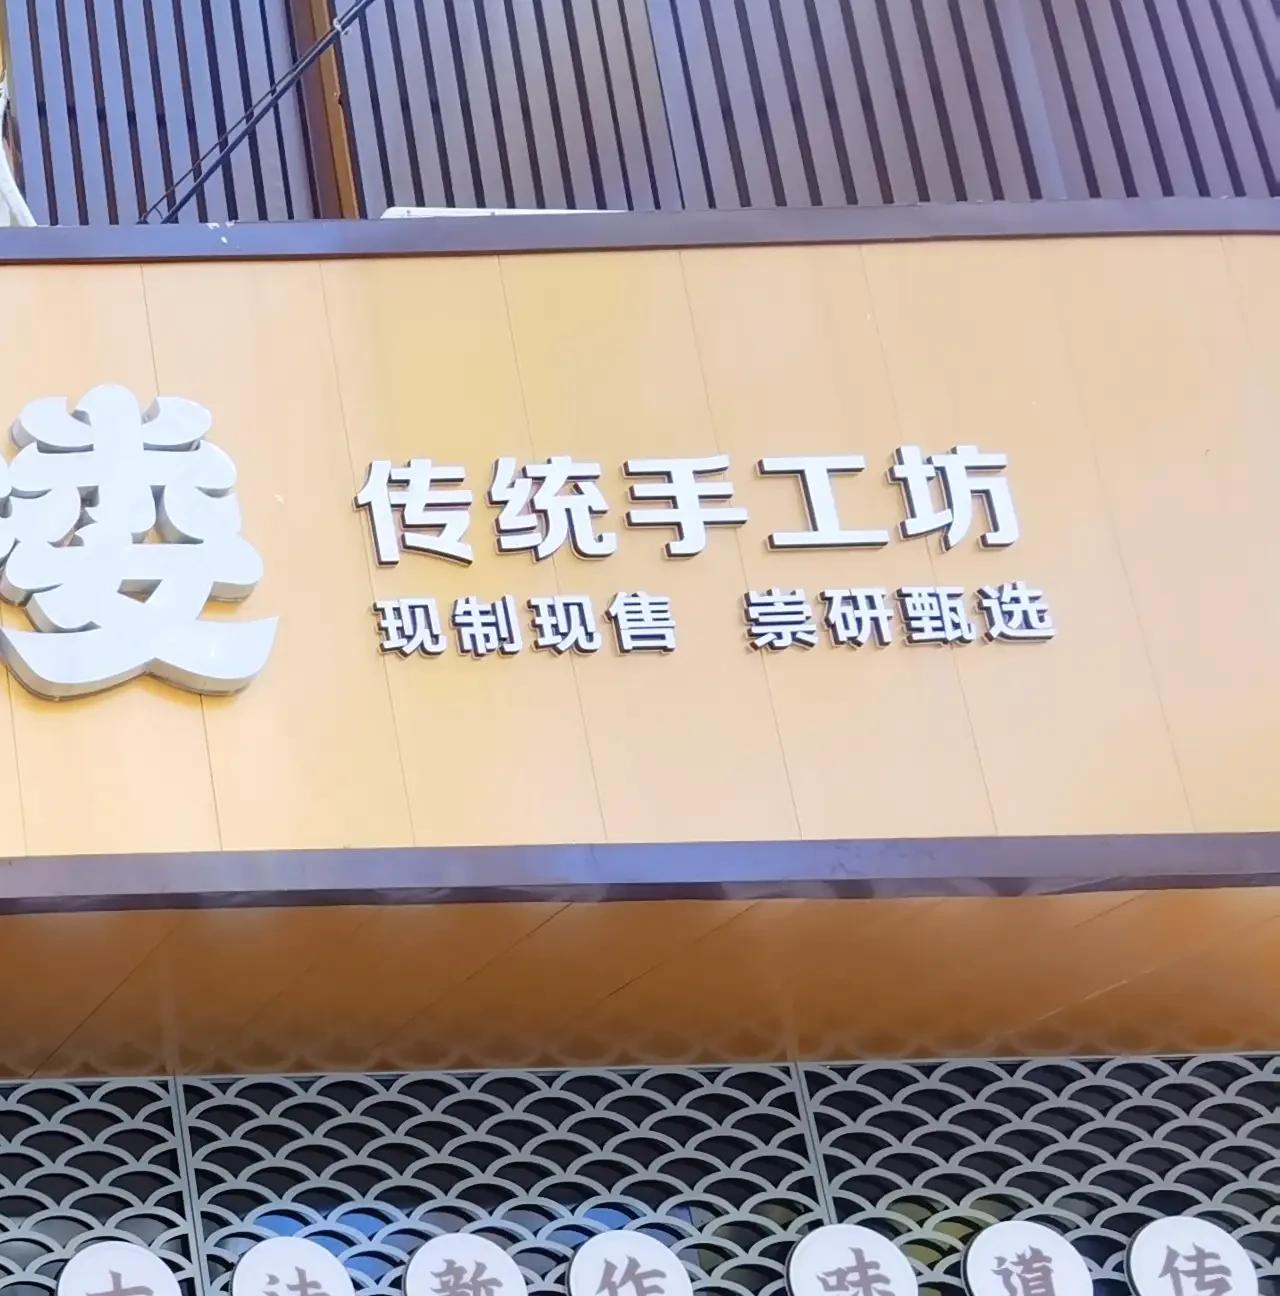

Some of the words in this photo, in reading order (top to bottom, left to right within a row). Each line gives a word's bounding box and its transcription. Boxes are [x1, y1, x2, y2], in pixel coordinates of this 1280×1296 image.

[354, 444, 1022, 567] 传统手工坊
[371, 590, 678, 657] 现制现售
[745, 580, 1058, 652] 崇研甄选
